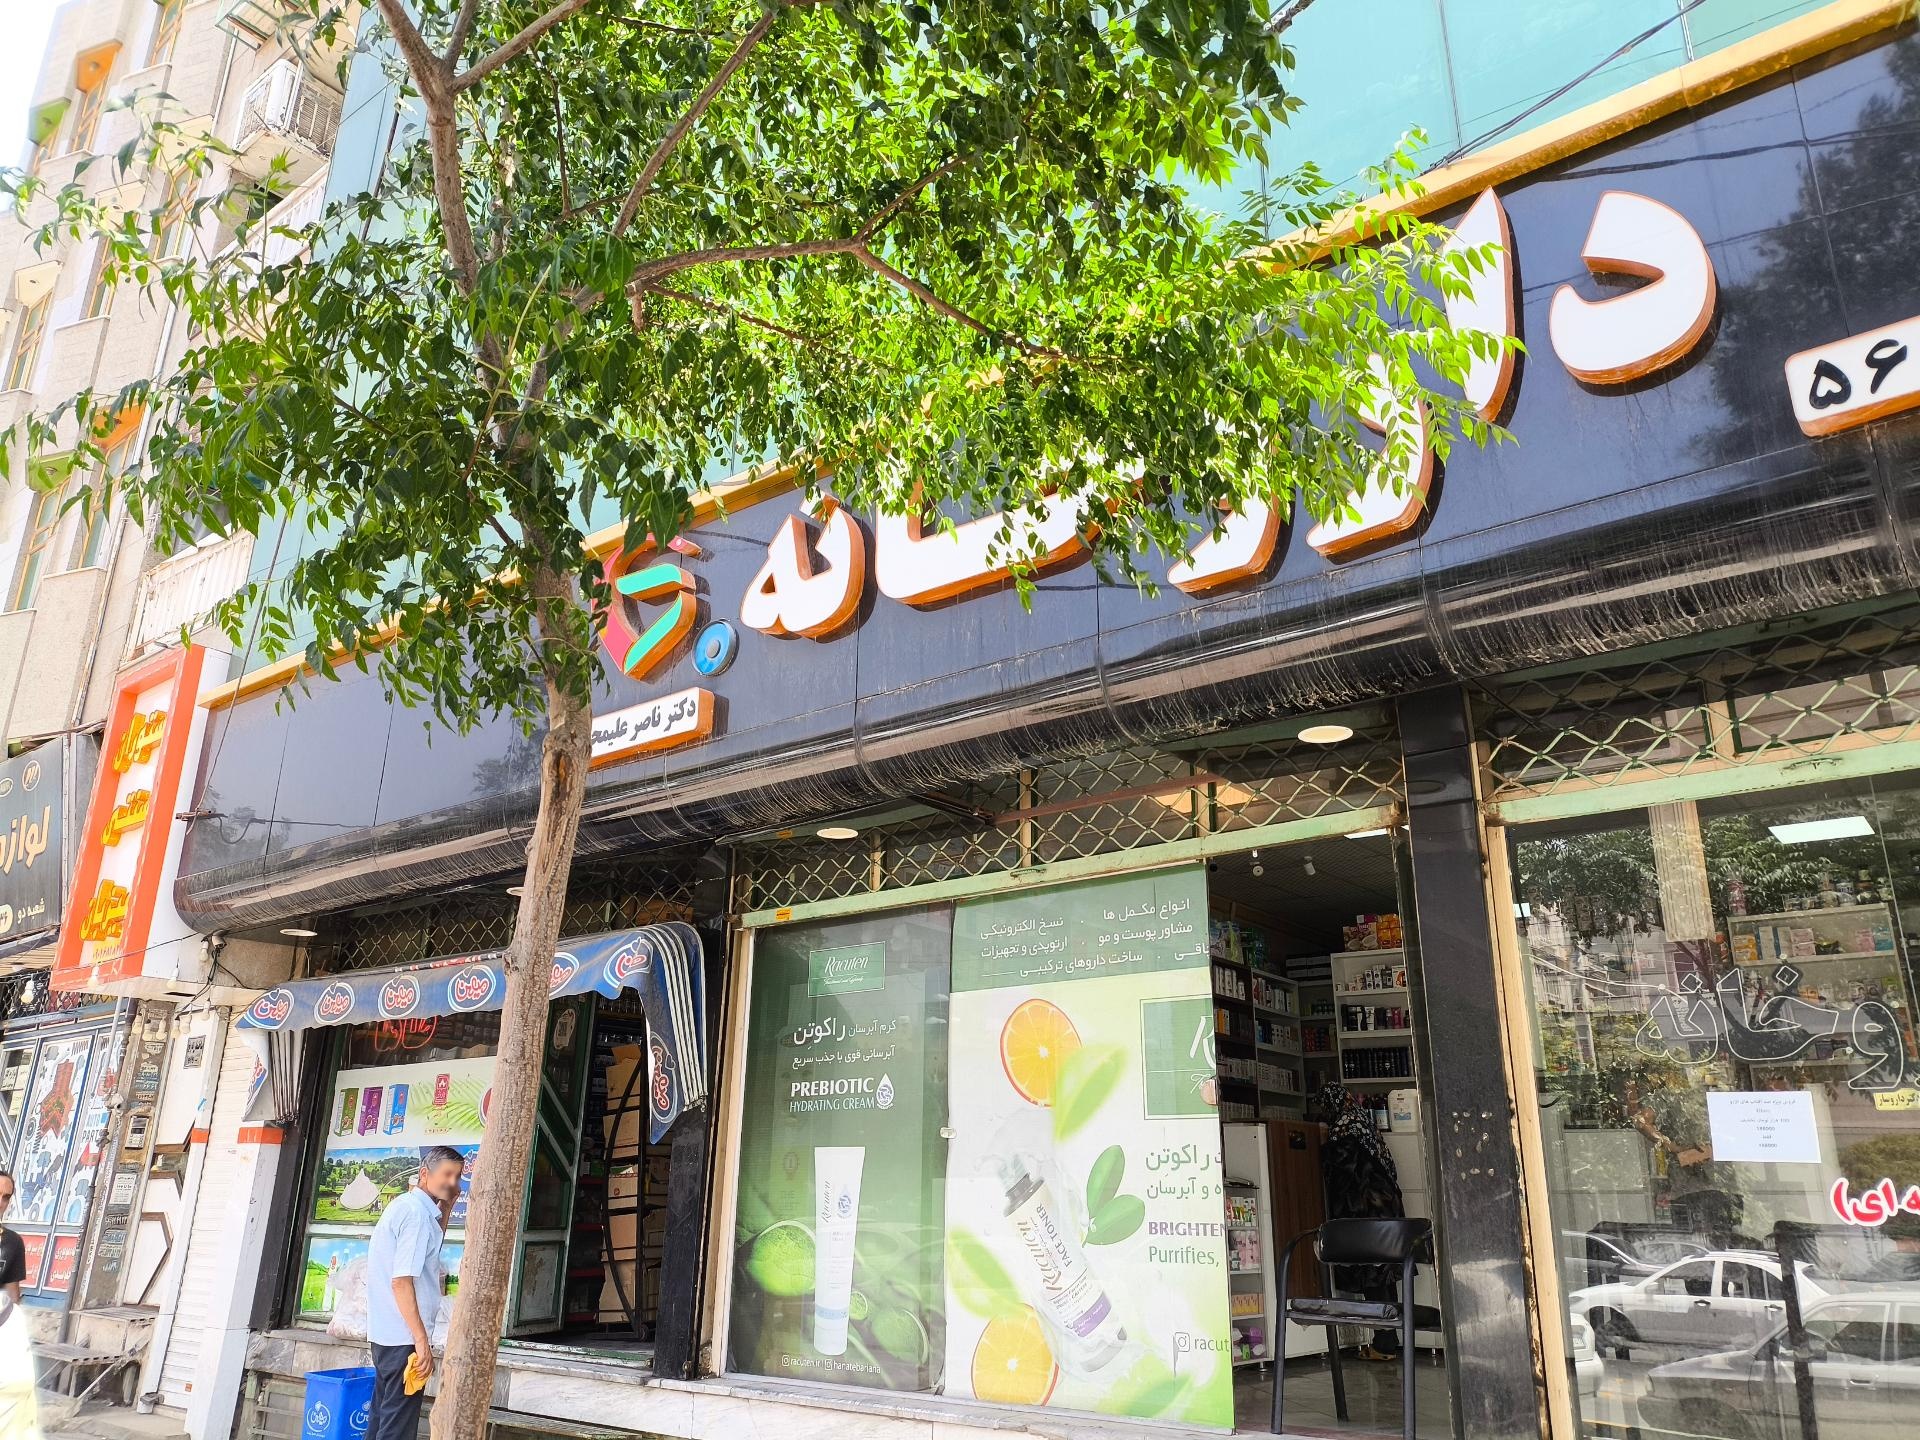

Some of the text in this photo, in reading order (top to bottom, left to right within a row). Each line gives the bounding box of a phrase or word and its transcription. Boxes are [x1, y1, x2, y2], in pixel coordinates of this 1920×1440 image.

[740, 184, 1717, 642] دارونه
[591, 697, 697, 746] دکتر ناصر علیمح
[80, 878, 130, 942] یزبان
[1102, 898, 1191, 922] انواع مکمل ها
[980, 917, 1064, 941] نسخ الکترونیکی
[1098, 923, 1193, 947] مشاور پوست و مو
[981, 936, 1069, 960] ارتوپدی و تجهیزات
[825, 955, 869, 977] Racuten
[1019, 950, 1143, 978] ساخت داروهای ترکیبی
[848, 1019, 879, 1038] آبرسان
[879, 1019, 897, 1035] کرم
[1635, 964, 1920, 1090] وخانه
[792, 1044, 896, 1070] آبرسانی قوی با جذب سریع
[790, 1077, 874, 1098] PREBIOTIC
[789, 1099, 840, 1113] HYDRATING
[842, 1097, 875, 1111] CREAM
[82, 1129, 101, 1141] PART
[1146, 1177, 1197, 1200] آبرسان
[1036, 1203, 1073, 1268] FACE TONER
[1148, 1246, 1220, 1268] Purrifies,
